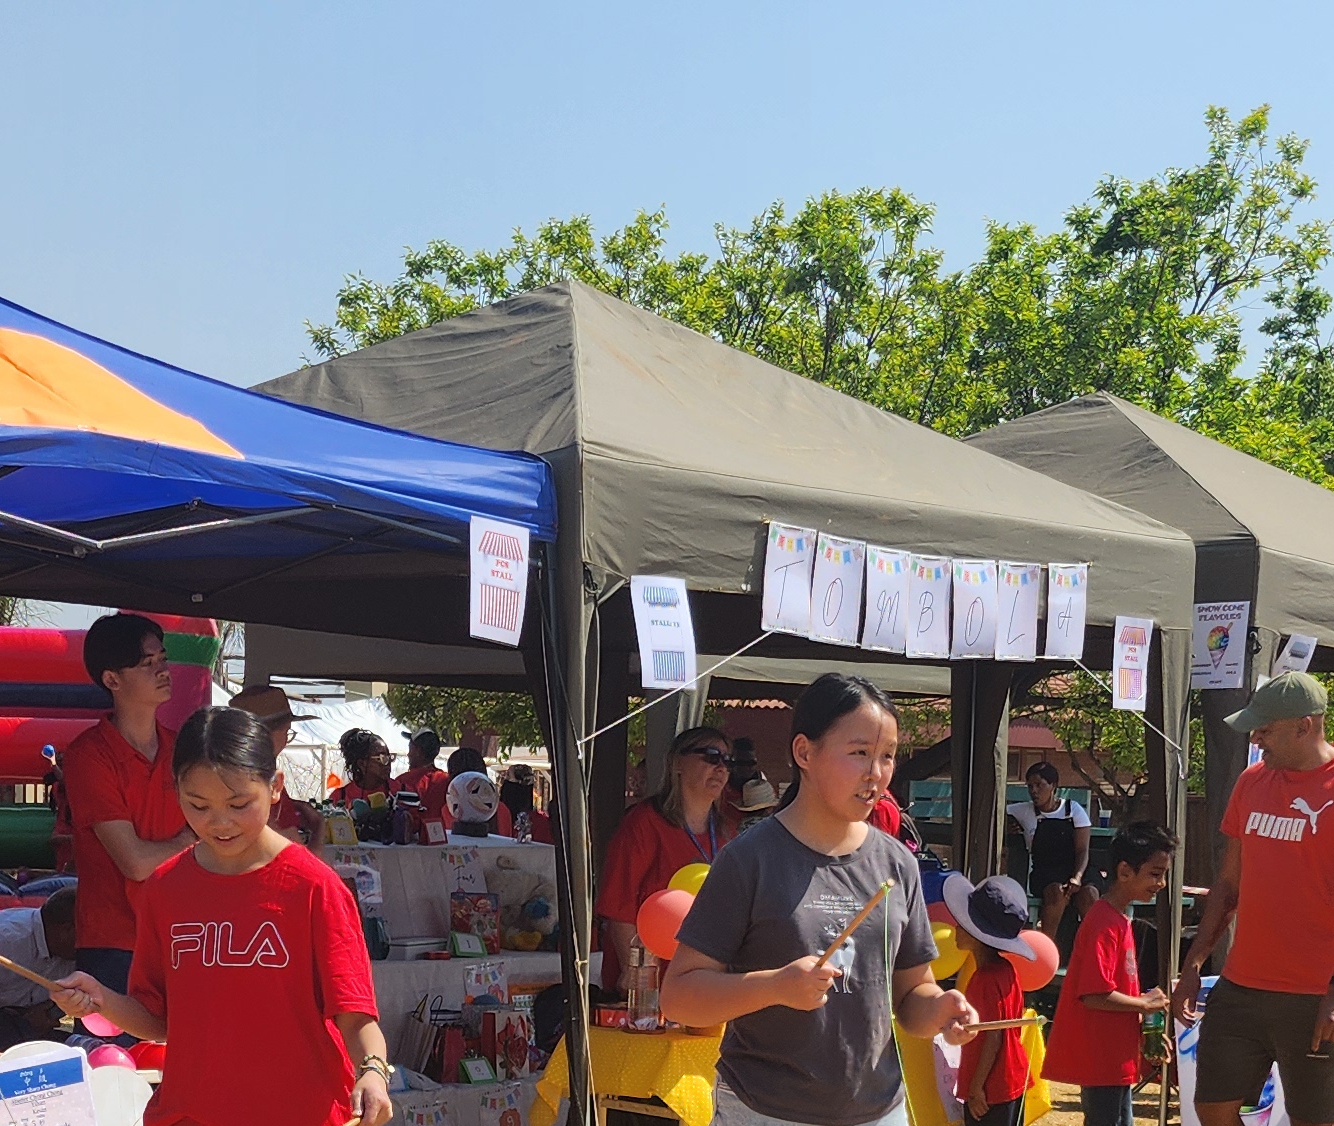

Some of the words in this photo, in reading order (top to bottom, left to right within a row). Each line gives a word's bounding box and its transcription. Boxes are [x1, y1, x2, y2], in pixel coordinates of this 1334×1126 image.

[1198, 603, 1221, 613] SNOW
[1222, 603, 1245, 612] CONE
[1245, 812, 1306, 842] PUMA
[171, 921, 290, 970] FILA
